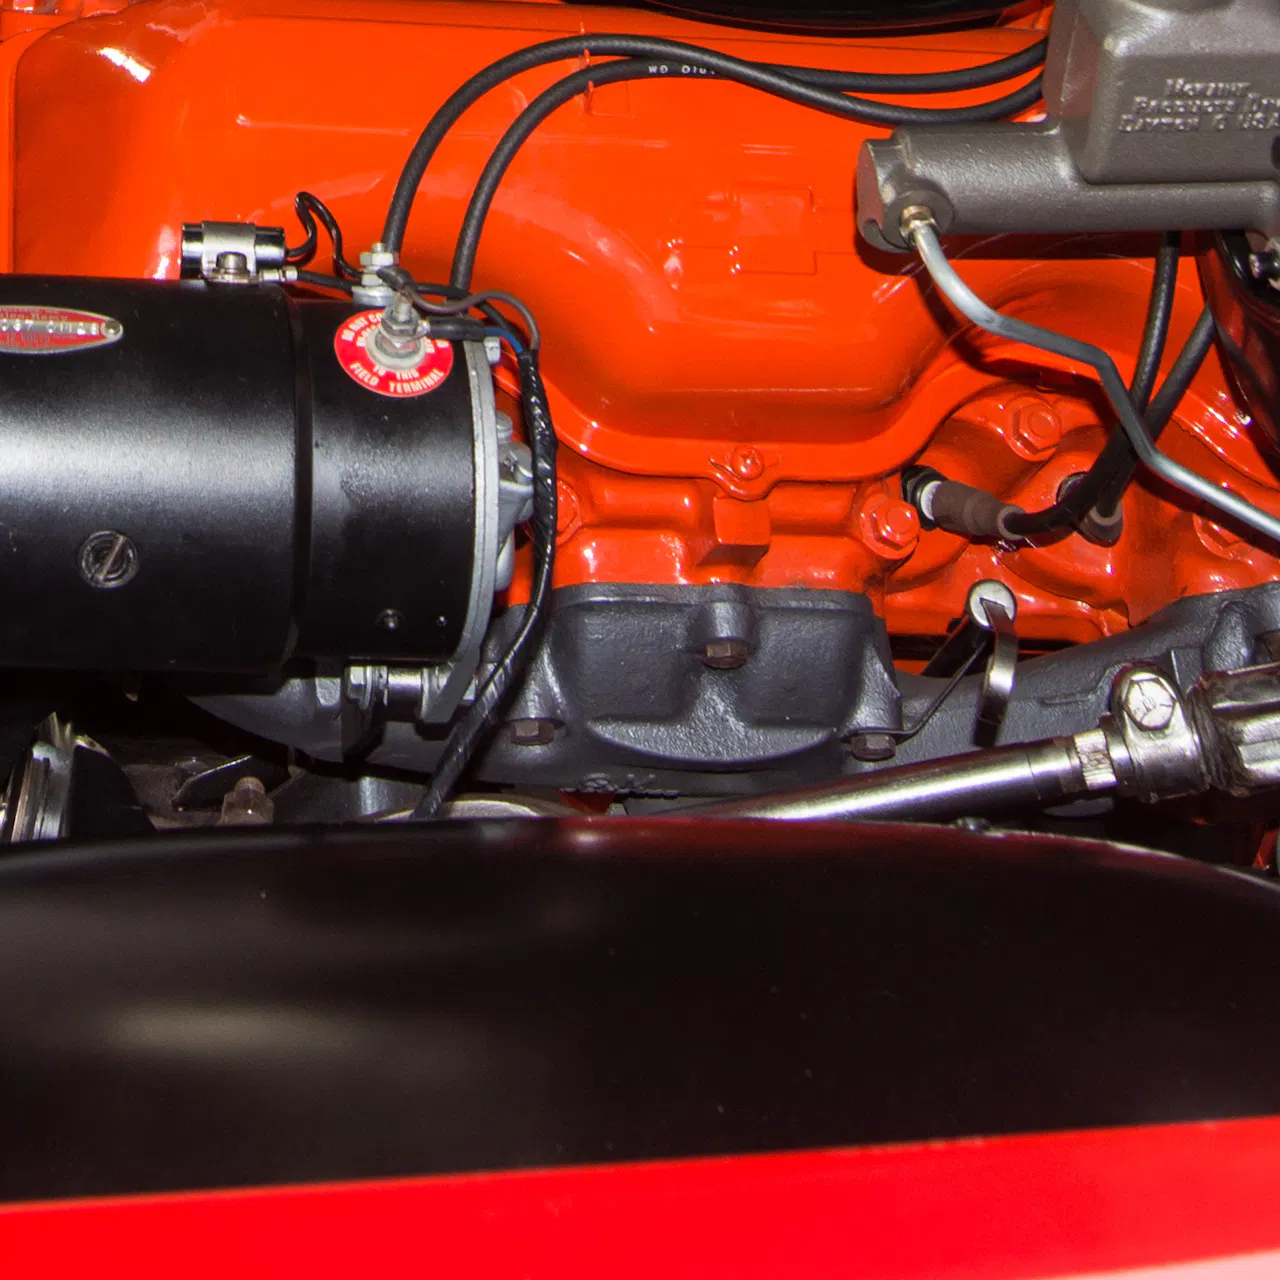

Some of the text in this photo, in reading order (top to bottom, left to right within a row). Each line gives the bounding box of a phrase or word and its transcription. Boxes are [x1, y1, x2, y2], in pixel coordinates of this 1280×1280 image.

[373, 364, 386, 376] TO
[395, 367, 420, 380] THIS
[349, 362, 445, 393] FIELD TERMINAL
